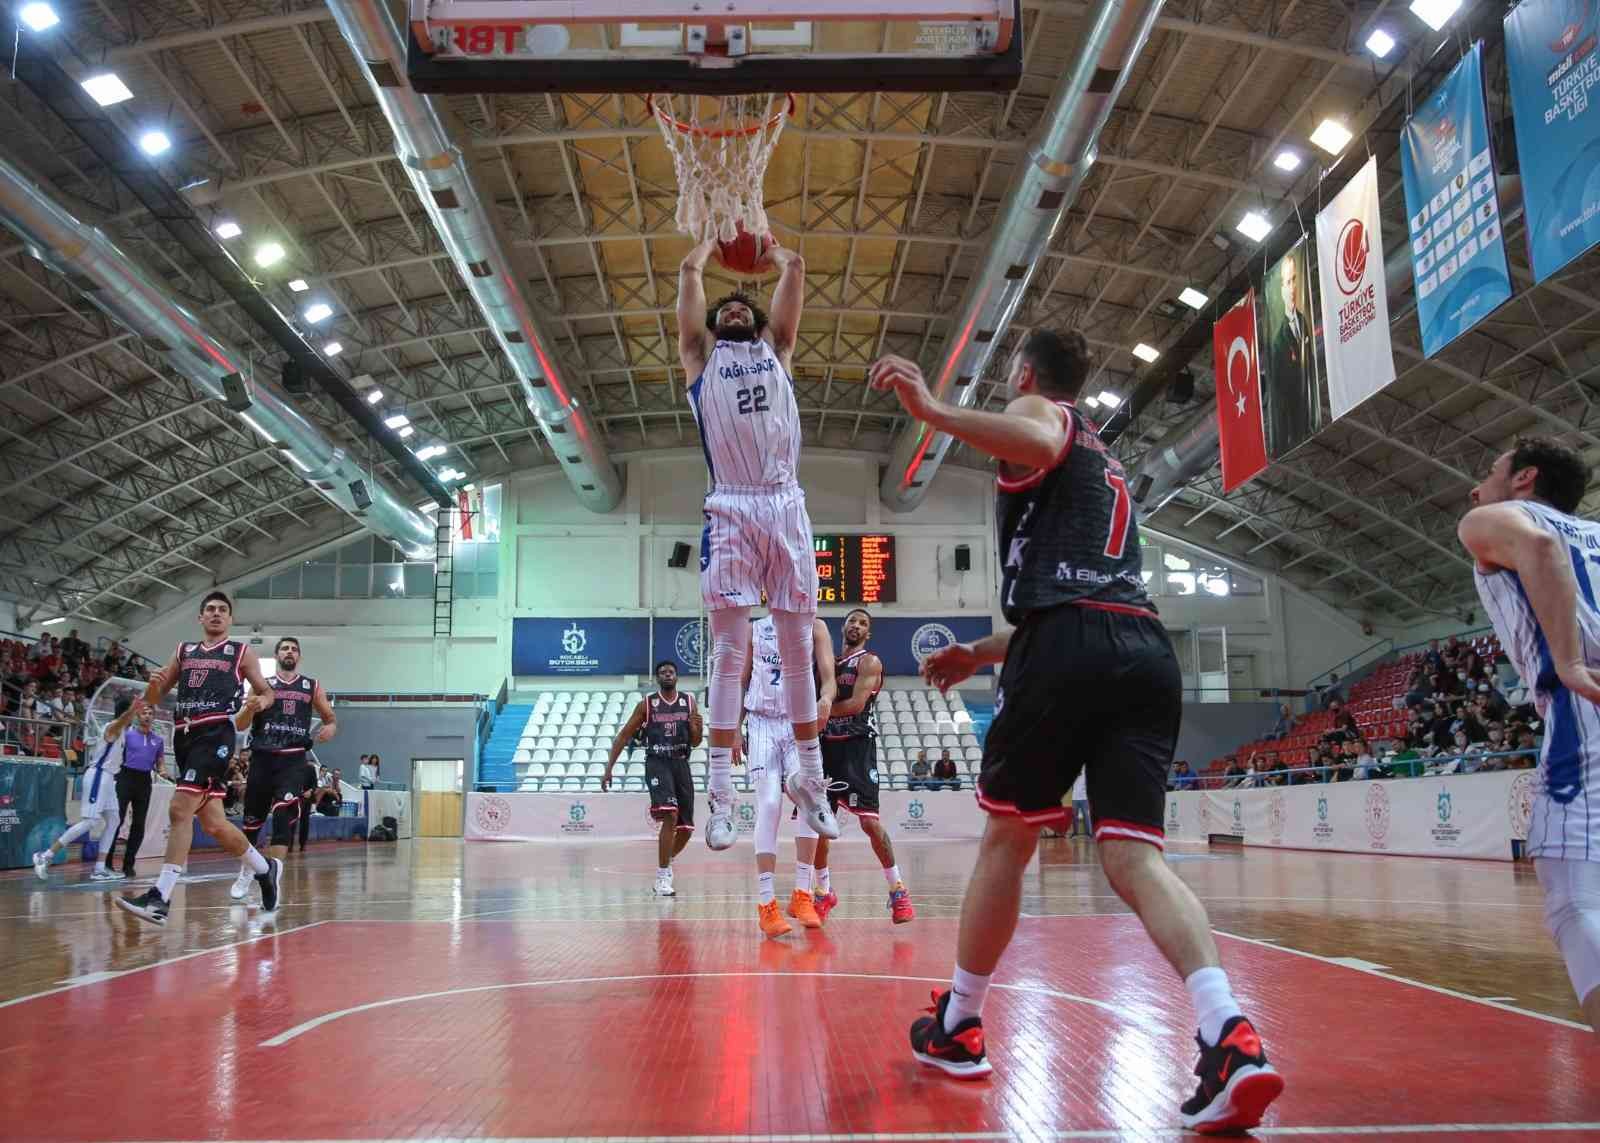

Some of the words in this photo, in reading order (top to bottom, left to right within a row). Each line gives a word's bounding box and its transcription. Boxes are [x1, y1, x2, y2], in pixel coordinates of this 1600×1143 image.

[736, 384, 769, 415] 22
[1104, 467, 1132, 559] 7
[187, 669, 209, 688] 57
